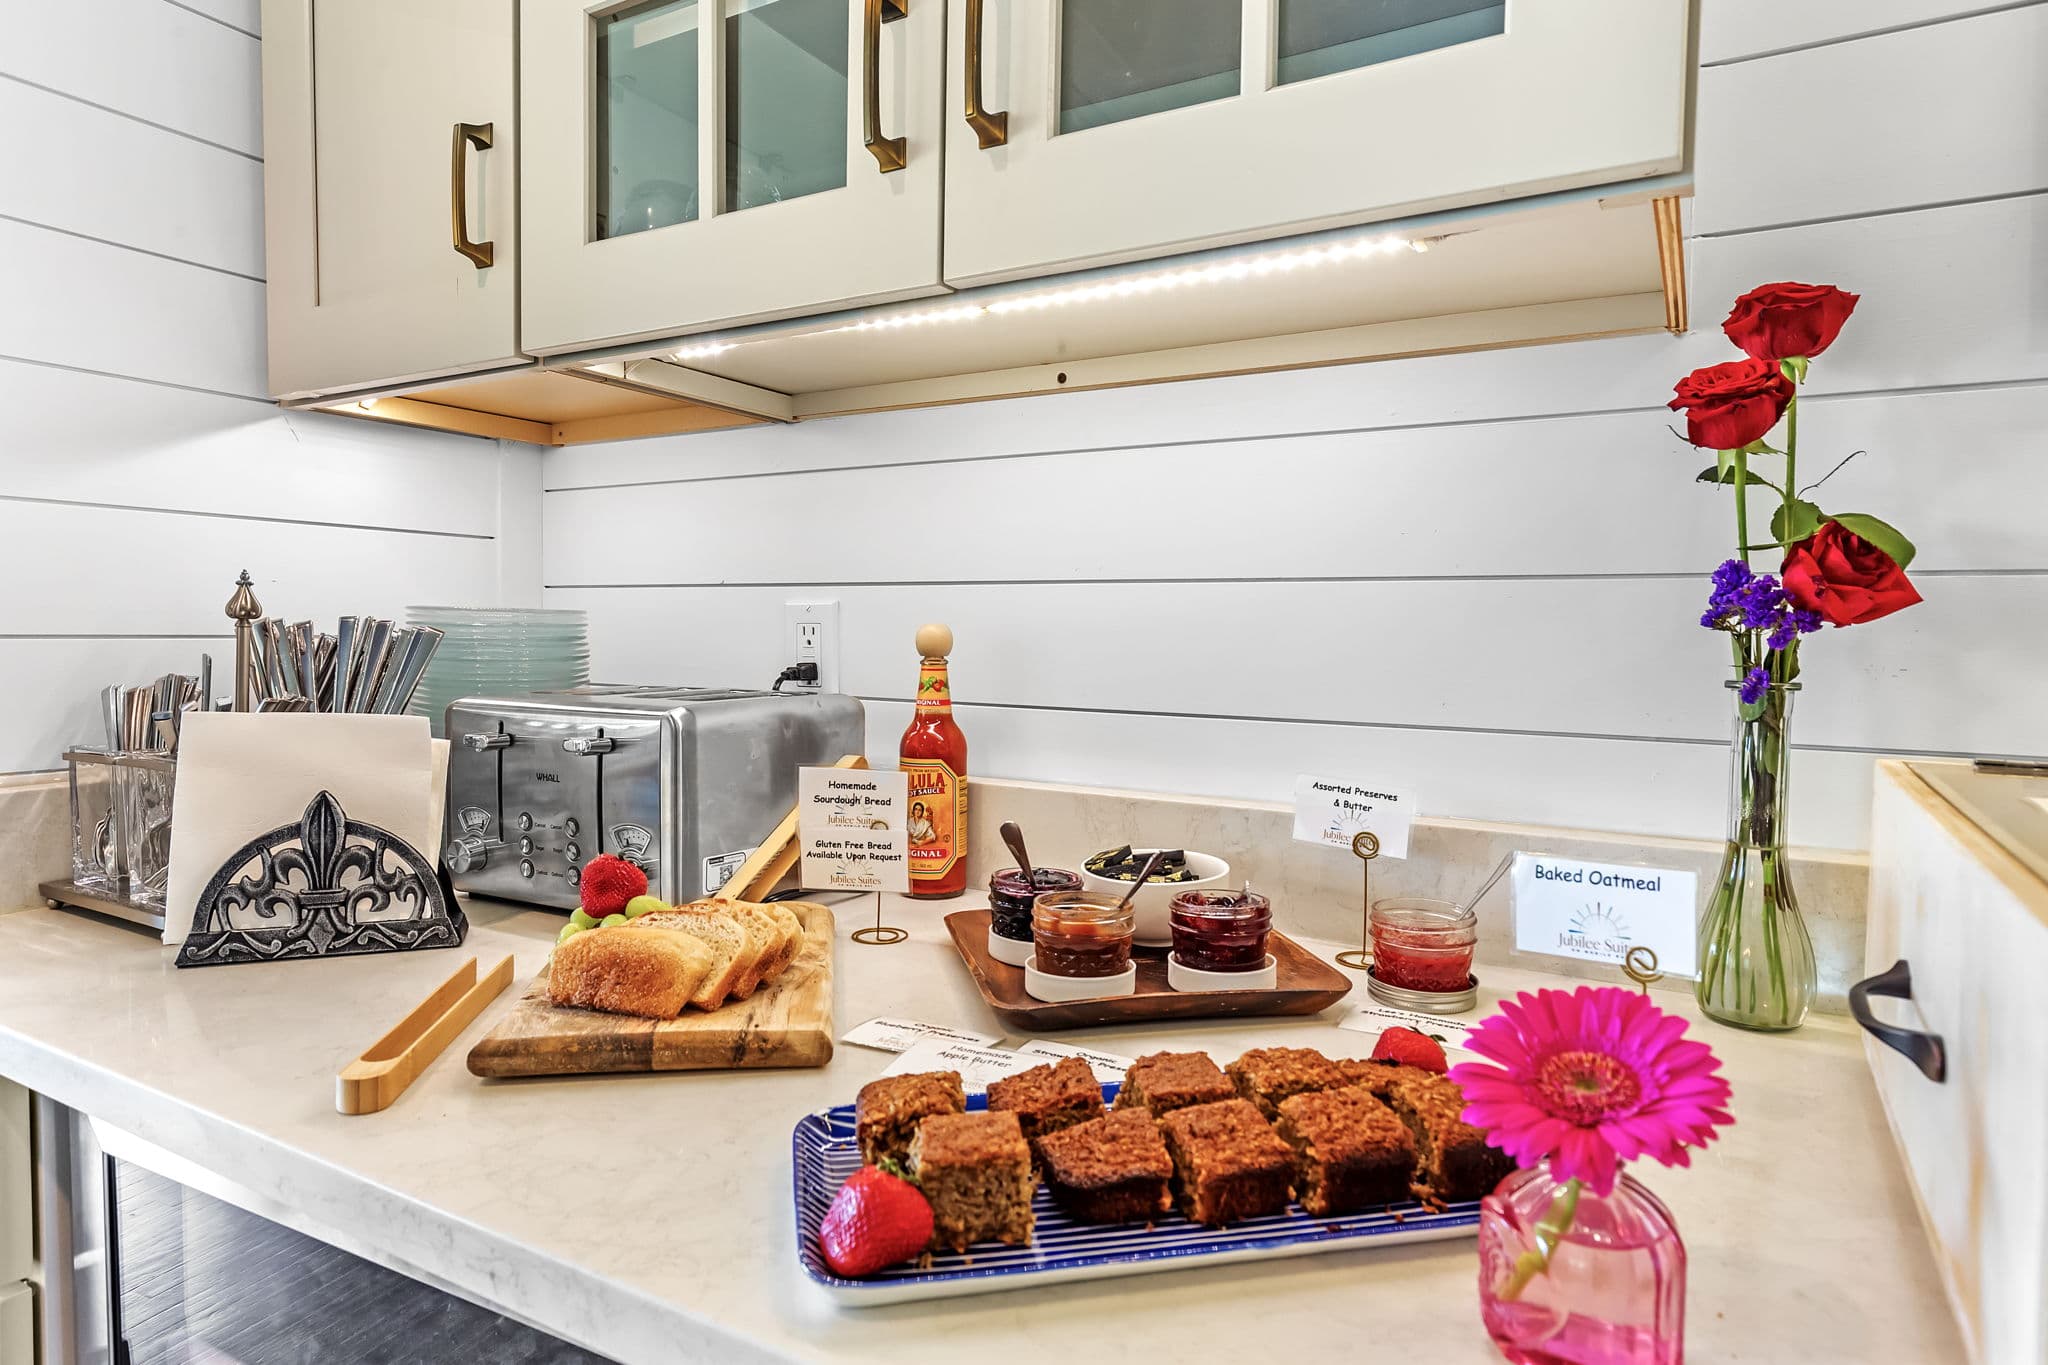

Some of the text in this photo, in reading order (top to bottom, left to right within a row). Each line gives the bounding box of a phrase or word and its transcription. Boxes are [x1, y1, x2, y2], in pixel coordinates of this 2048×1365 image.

[828, 780, 877, 791] Homemade
[910, 773, 945, 789] LULA
[1312, 782, 1398, 801] Assorted Preserves
[813, 794, 892, 806] Sourdough Bread
[1333, 799, 1373, 812] & Butter
[827, 814, 855, 825] Jubilee
[815, 840, 892, 850] Gluten Free Bread
[806, 851, 902, 863] Available Upon Request
[829, 874, 882, 885] Jubilee Suites
[1535, 864, 1661, 892] Baked Oatmeal
[1557, 932, 1600, 950] Jubilee
[937, 1050, 1013, 1068] Apple Butter
[950, 1045, 1013, 1060] Homemade
